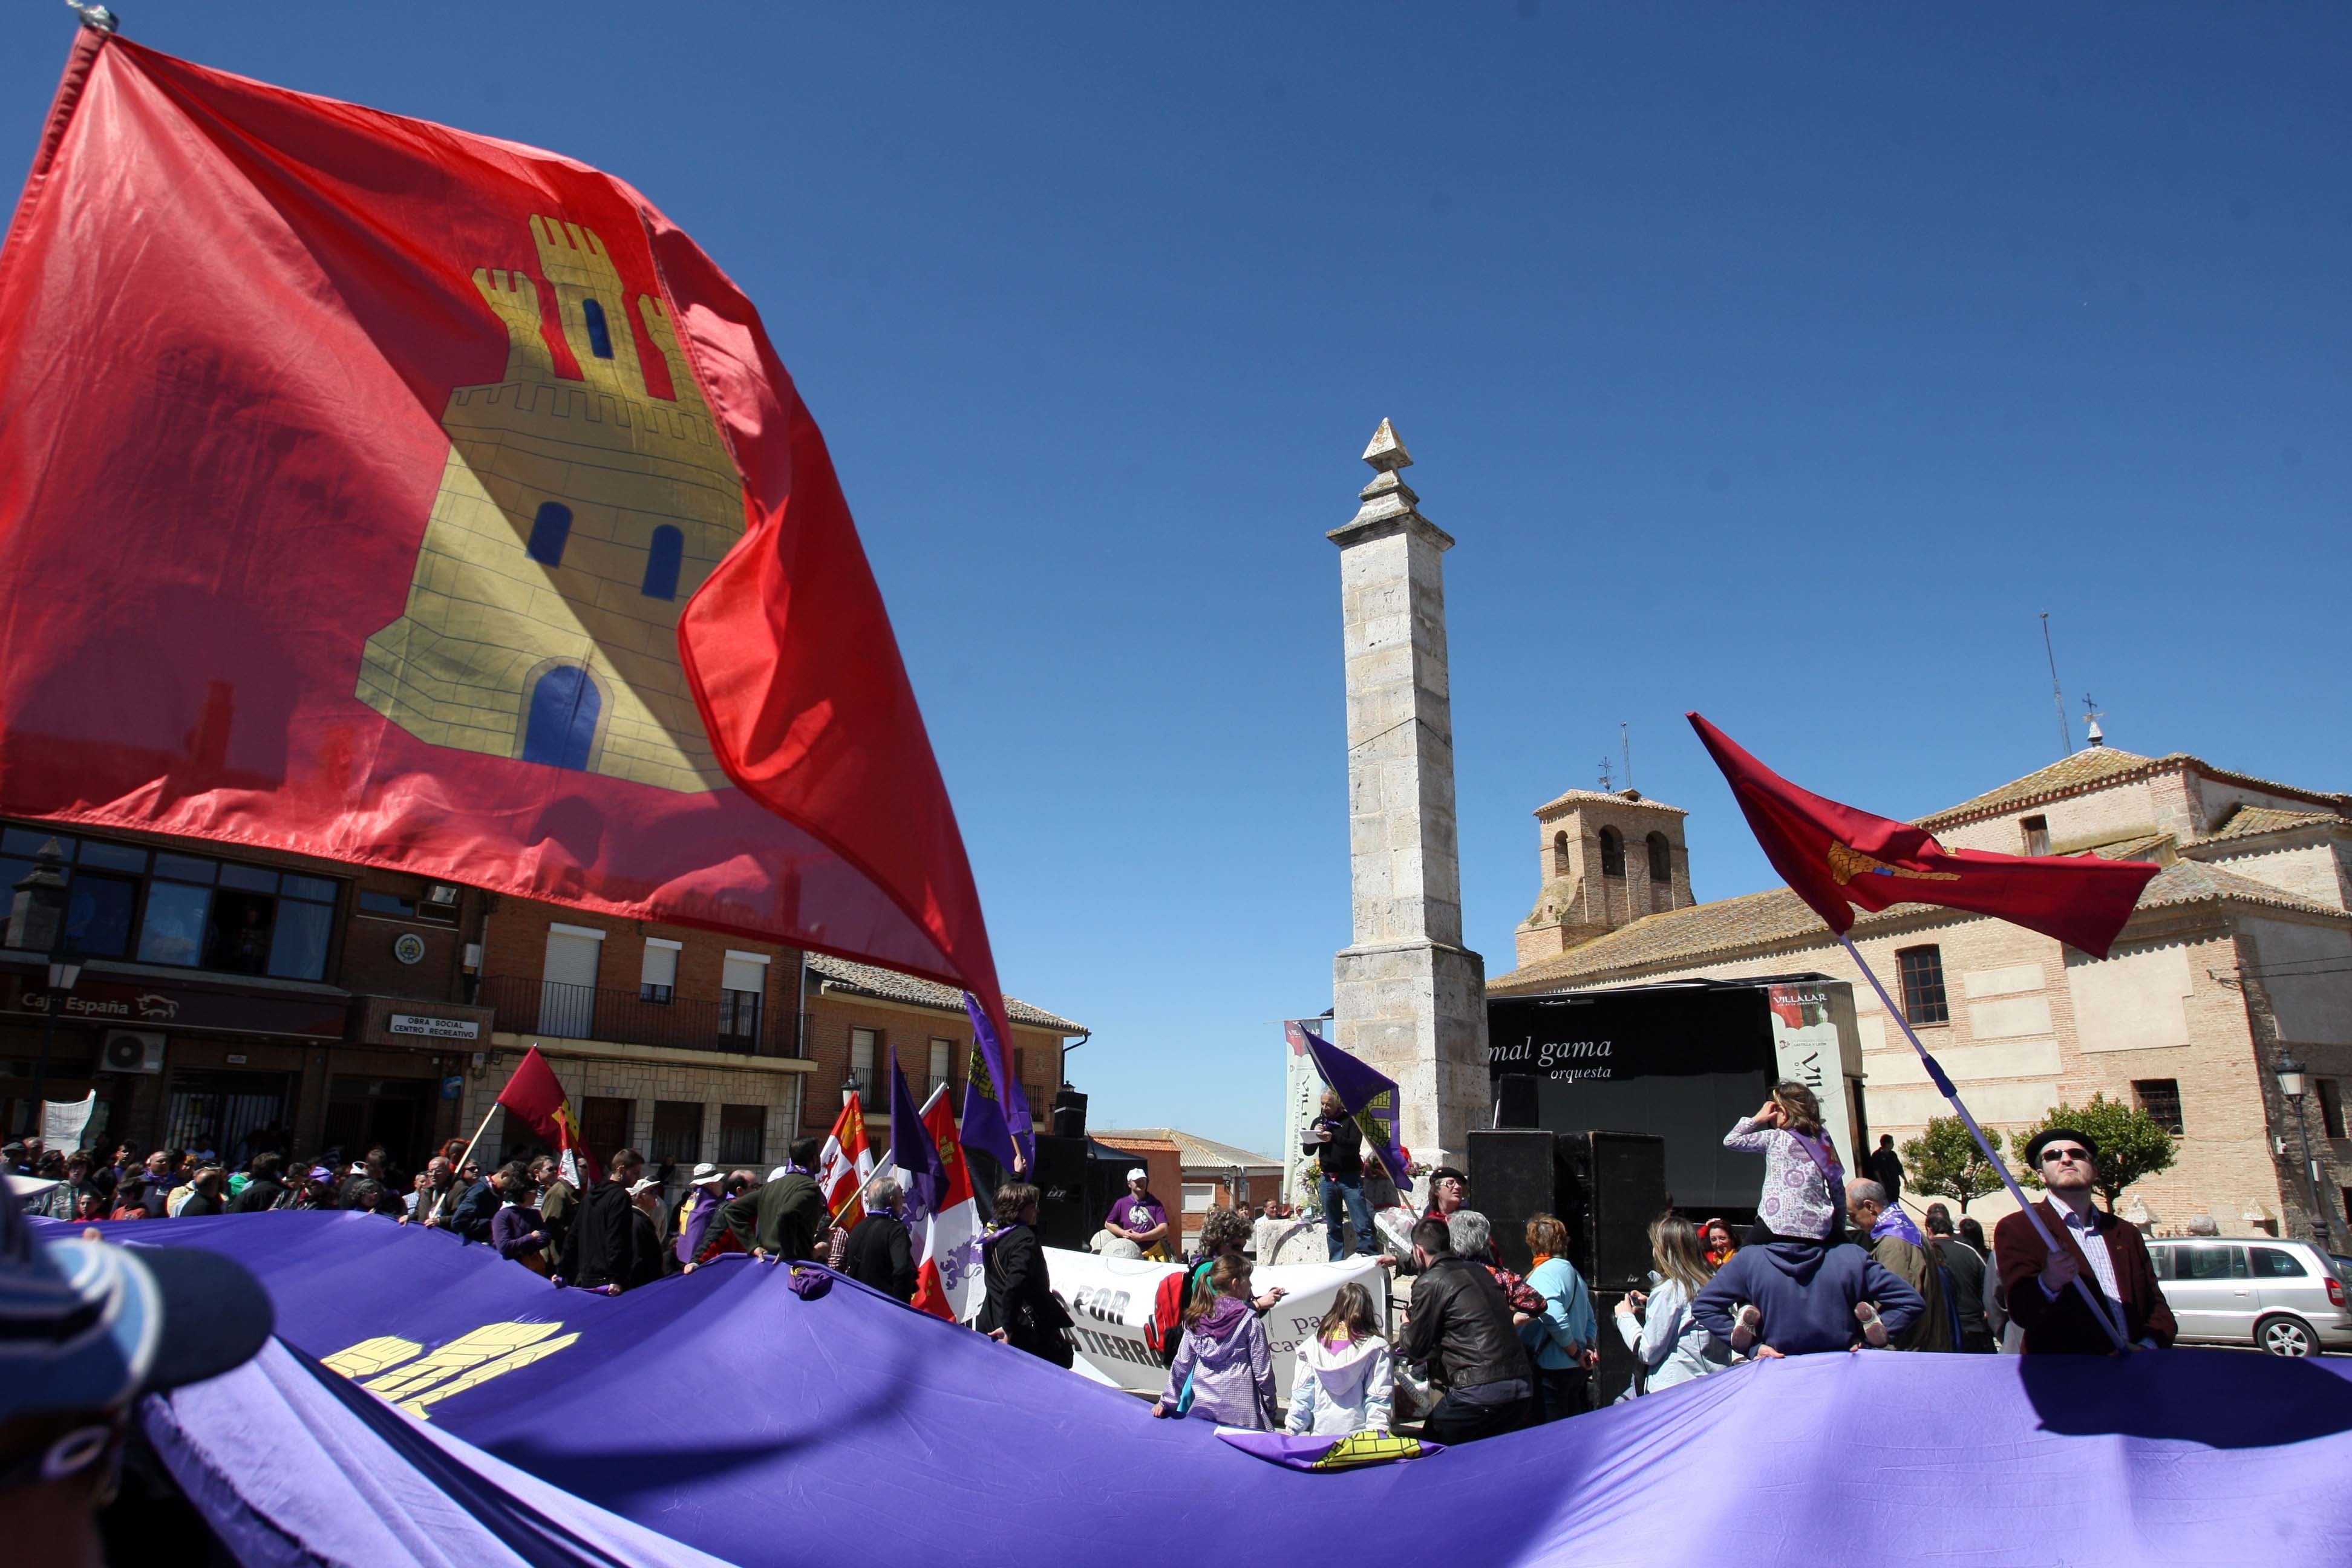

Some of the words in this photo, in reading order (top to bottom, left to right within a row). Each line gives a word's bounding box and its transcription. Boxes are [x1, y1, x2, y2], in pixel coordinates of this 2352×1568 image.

[22, 993, 60, 1011] Caj
[66, 997, 129, 1015] España
[1773, 993, 1828, 1003] VILLALAR
[408, 1017, 430, 1025] OBRA
[435, 1020, 464, 1028] SOCIAL
[394, 1025, 424, 1034] CENTRO
[429, 1028, 474, 1038] RECREATIVO
[1488, 1036, 1532, 1062] mal
[1538, 1040, 1612, 1067] gama
[1550, 1066, 1612, 1083] orquesta
[1073, 1284, 1131, 1326] POR
